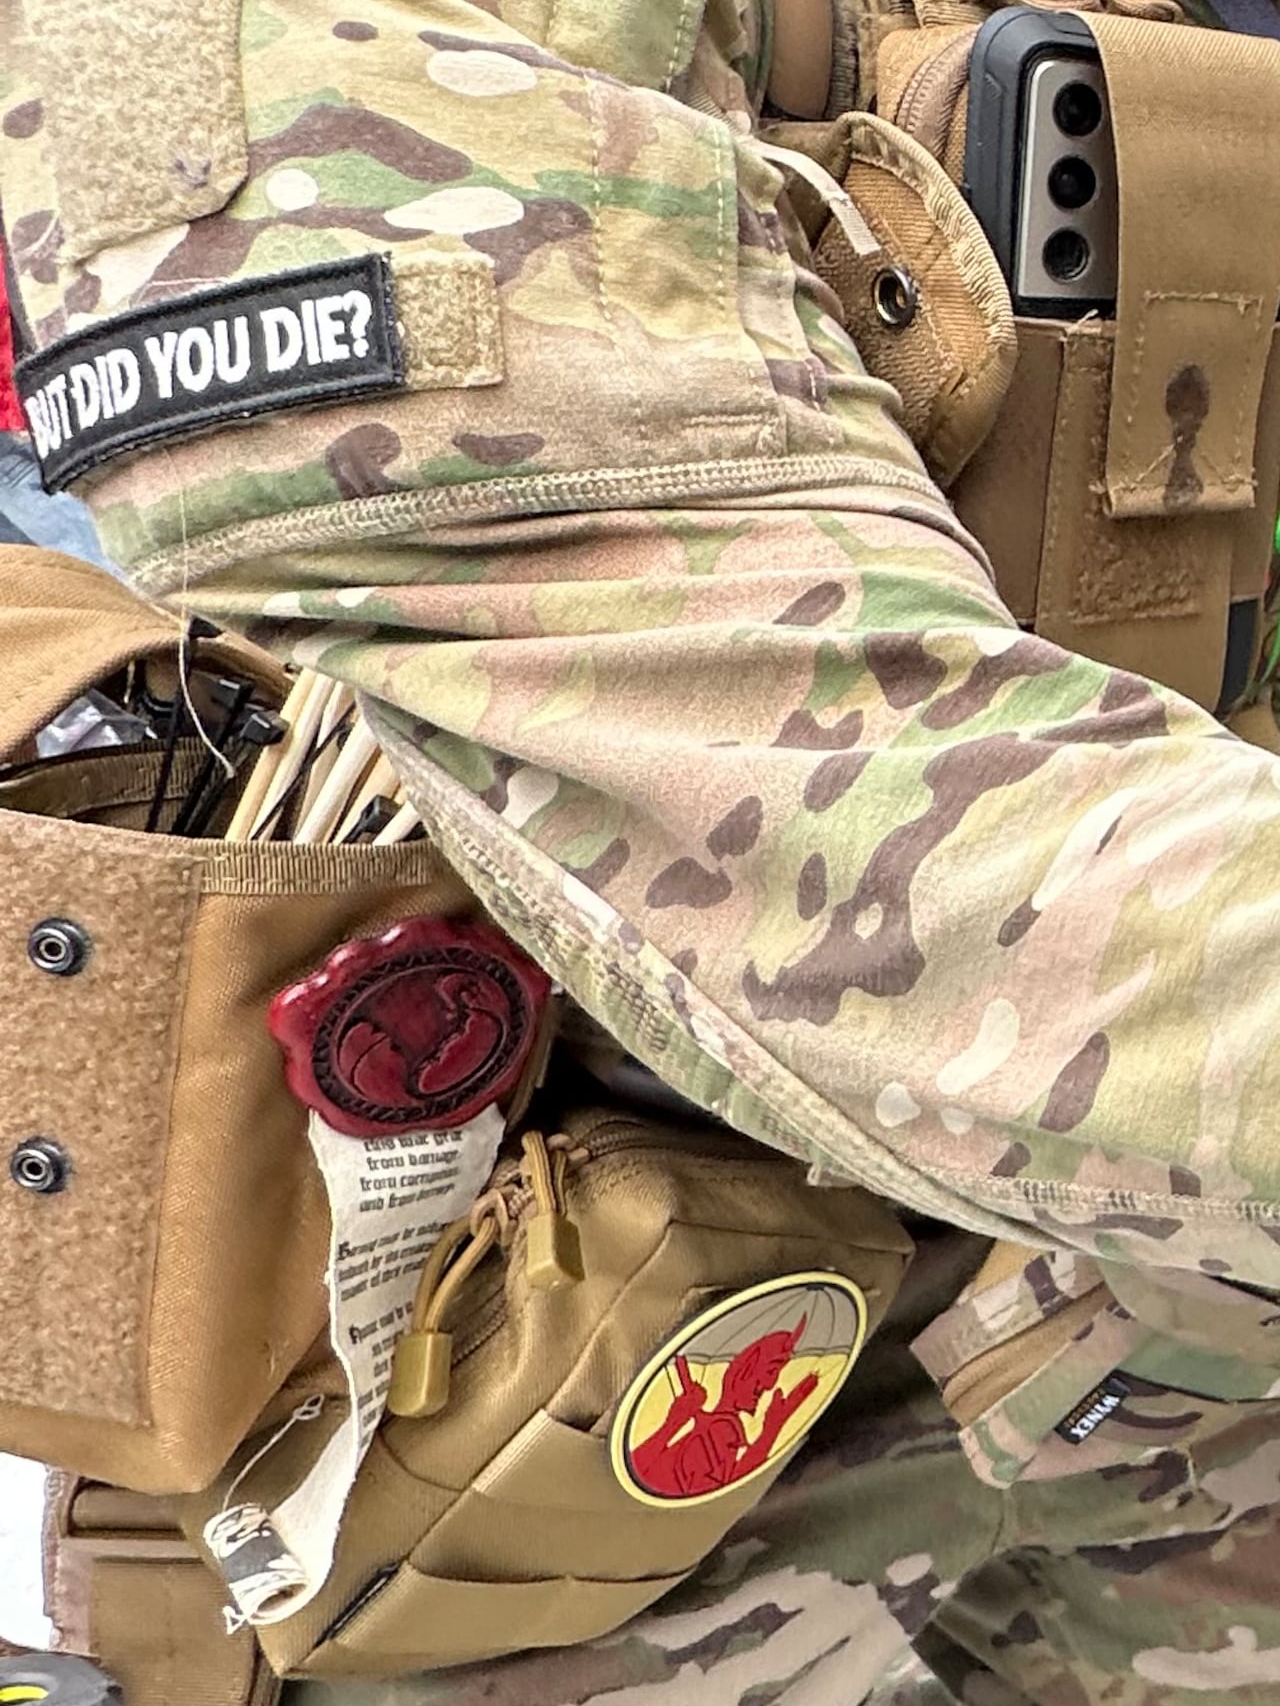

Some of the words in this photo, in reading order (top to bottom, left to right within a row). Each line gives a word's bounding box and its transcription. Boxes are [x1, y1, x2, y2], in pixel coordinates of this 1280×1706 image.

[70, 348, 141, 430] DID
[145, 315, 251, 399] YOU
[260, 290, 373, 374] DIE?
